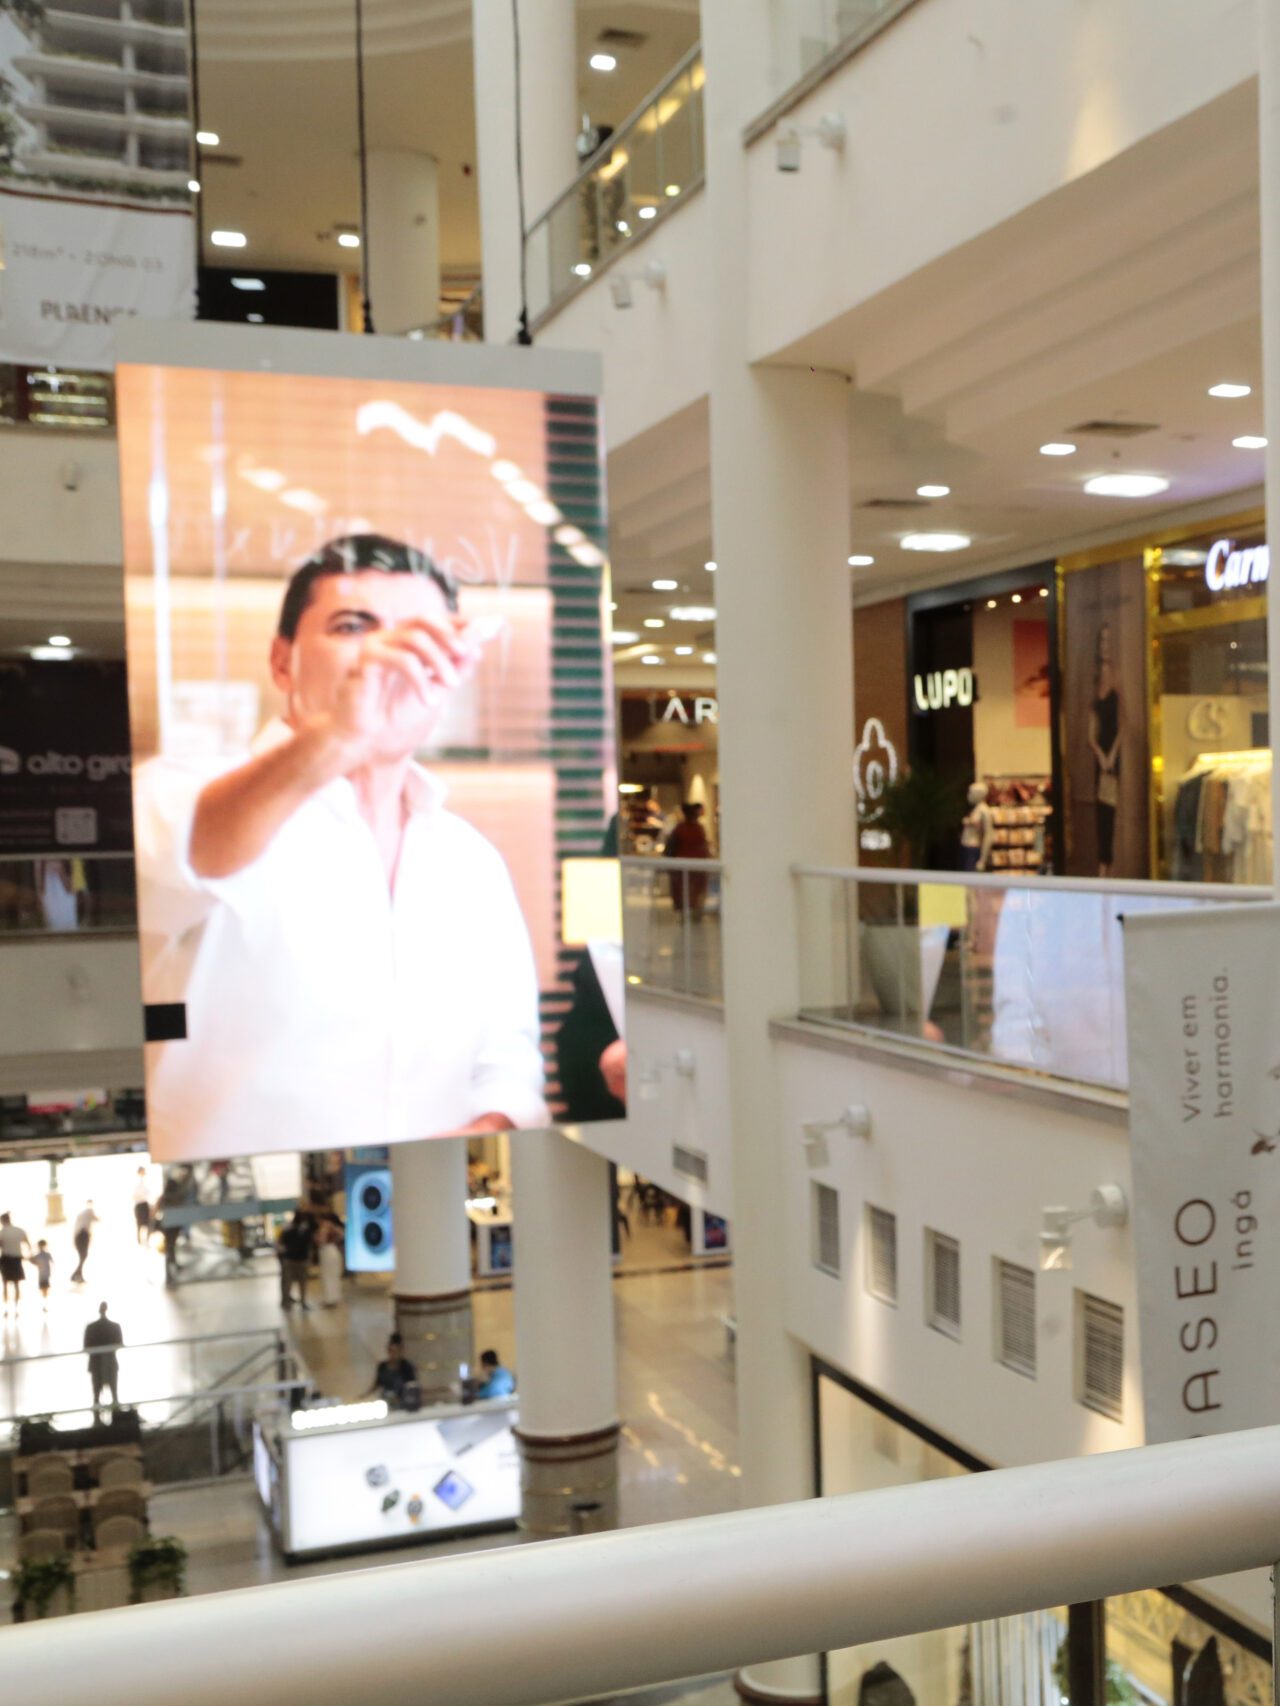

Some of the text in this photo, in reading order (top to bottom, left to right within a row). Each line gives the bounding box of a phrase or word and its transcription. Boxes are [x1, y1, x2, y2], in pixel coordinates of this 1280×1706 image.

[914, 668, 973, 711] LUPO
[1177, 995, 1201, 1123] Viver em
[1209, 967, 1233, 1118] harmonia.
[1174, 1197, 1222, 1438] ASEO
